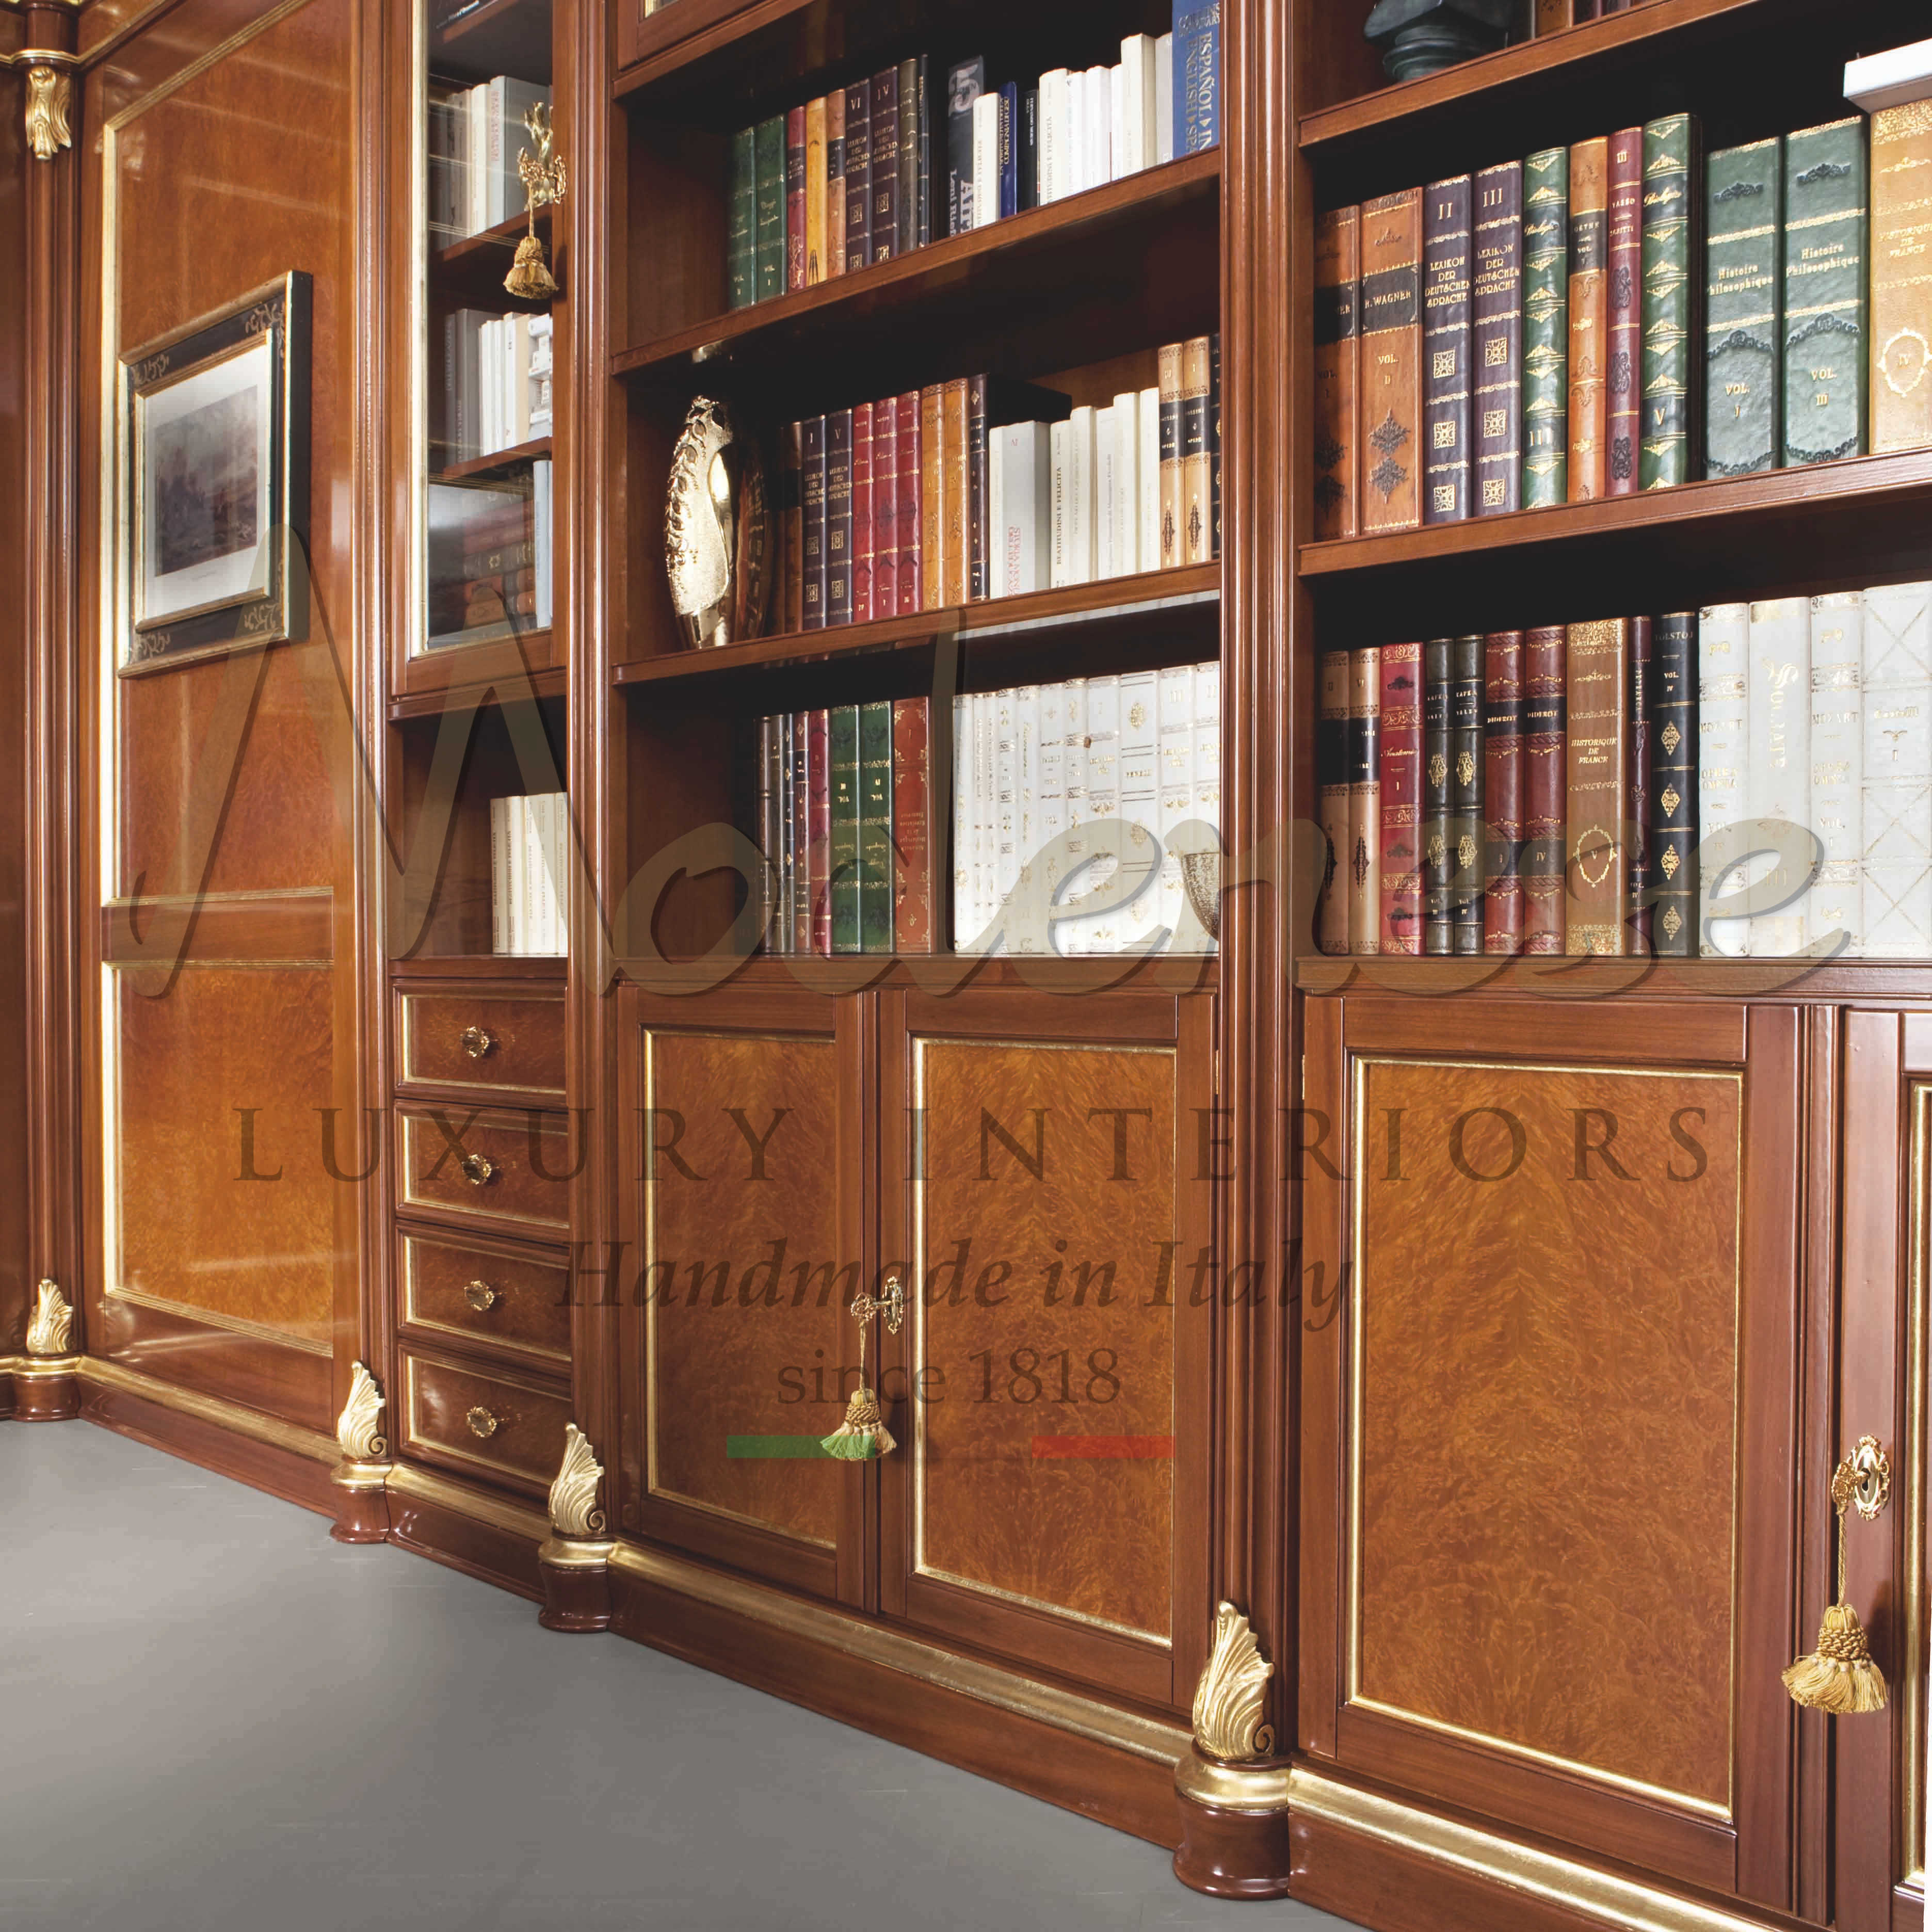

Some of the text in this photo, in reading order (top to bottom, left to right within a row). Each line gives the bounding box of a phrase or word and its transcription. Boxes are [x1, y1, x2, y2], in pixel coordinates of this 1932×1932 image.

[851, 98, 861, 110] VI
[1483, 187, 1503, 207] III
[1438, 202, 1453, 220] II
[1478, 243, 1515, 259] LEXIKON
[1801, 244, 1844, 260] Histoire
[1429, 256, 1466, 271] LEXIKON
[1486, 259, 1504, 270] DER
[1785, 256, 1859, 278] Philosophique
[1438, 270, 1456, 282] DER
[1718, 264, 1759, 280] Histoire
[1425, 280, 1470, 297] DEUTSCHEN
[1475, 279, 1516, 297] SPRACHE
[1707, 276, 1774, 296] hilosophique
[1373, 290, 1412, 307] WAGNER
[1427, 292, 1468, 308] SPRACHE
[1378, 353, 1399, 365] VOL.
[1811, 367, 1838, 381] VOL.
[1725, 383, 1750, 397] VOL.
[1816, 393, 1829, 406] III
[1654, 408, 1666, 426] V
[1487, 714, 1518, 724] DIDEROT
[1527, 710, 1558, 719] DIDEROT
[1571, 737, 1618, 747] HISTORIQUE
[1578, 755, 1609, 764] FRANCE
